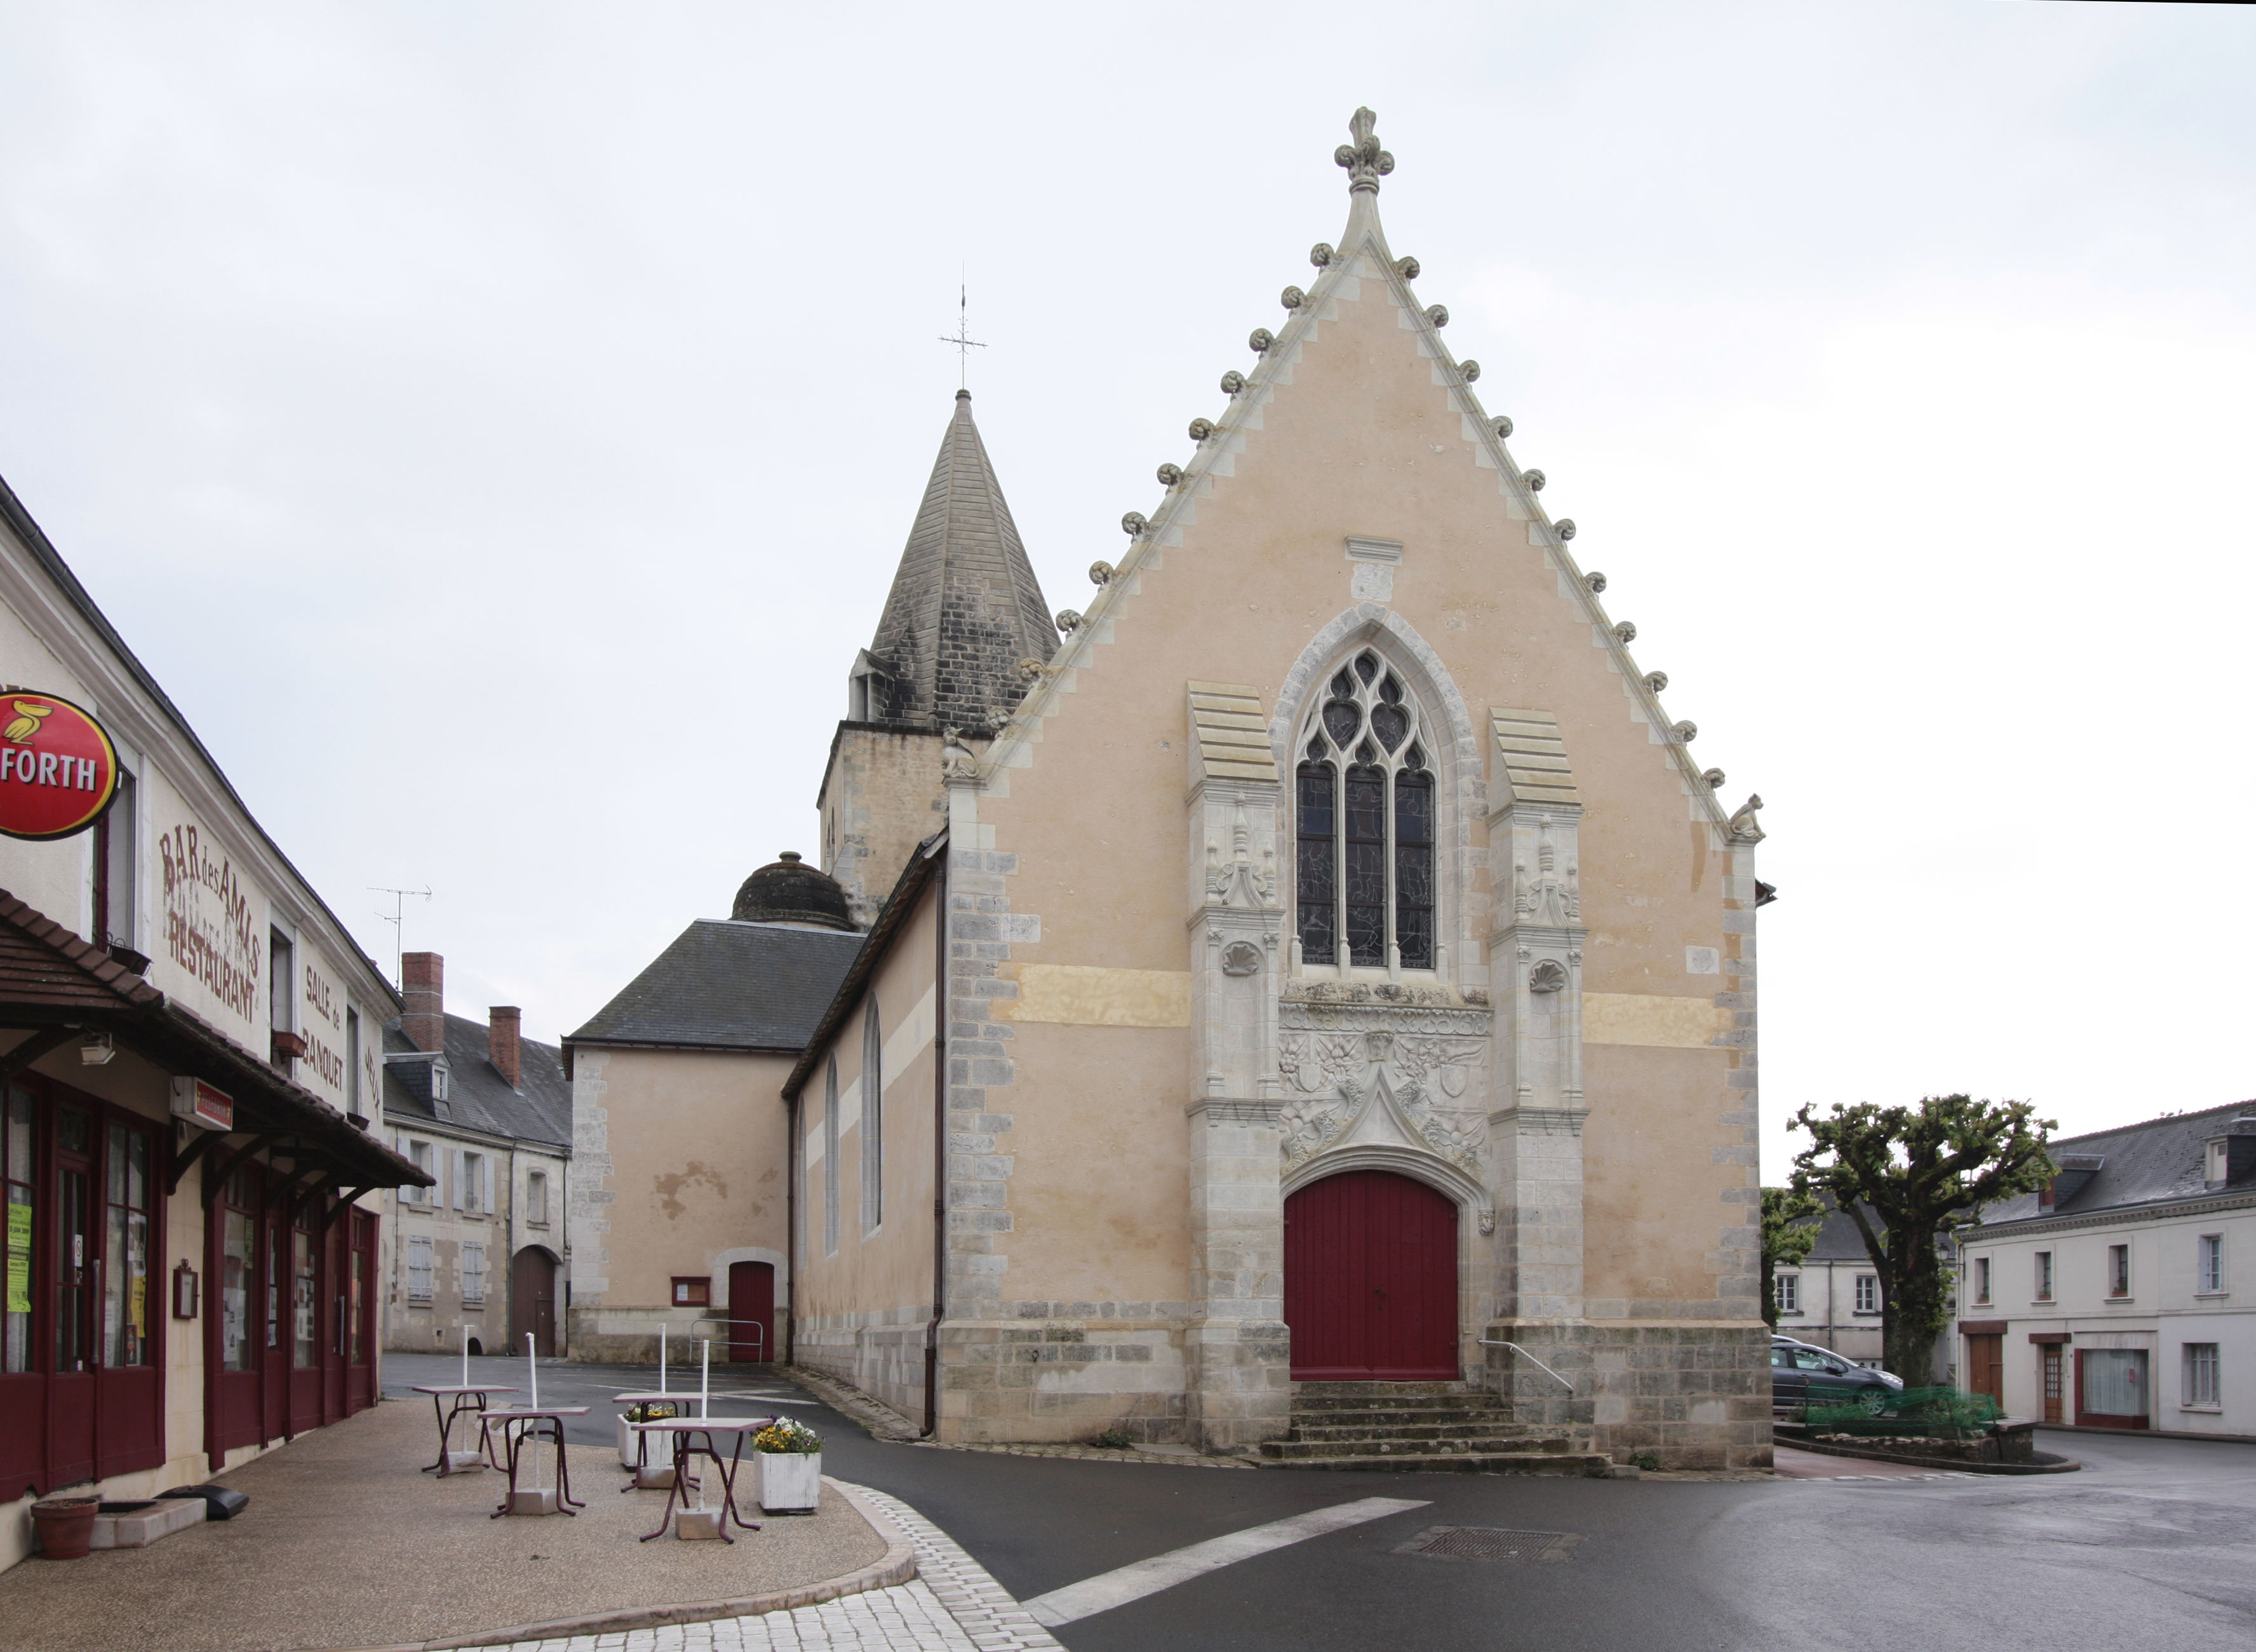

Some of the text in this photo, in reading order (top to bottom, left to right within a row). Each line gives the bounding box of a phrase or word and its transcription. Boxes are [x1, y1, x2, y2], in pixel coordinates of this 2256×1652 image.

[159, 824, 201, 897] BAR
[202, 845, 219, 895] des
[219, 856, 261, 979] AMIS
[169, 910, 255, 1024] RESTAURANT
[306, 964, 340, 1031] SALLE de
[302, 1027, 343, 1092] BANQUET
[365, 1045, 380, 1122] JEUX
